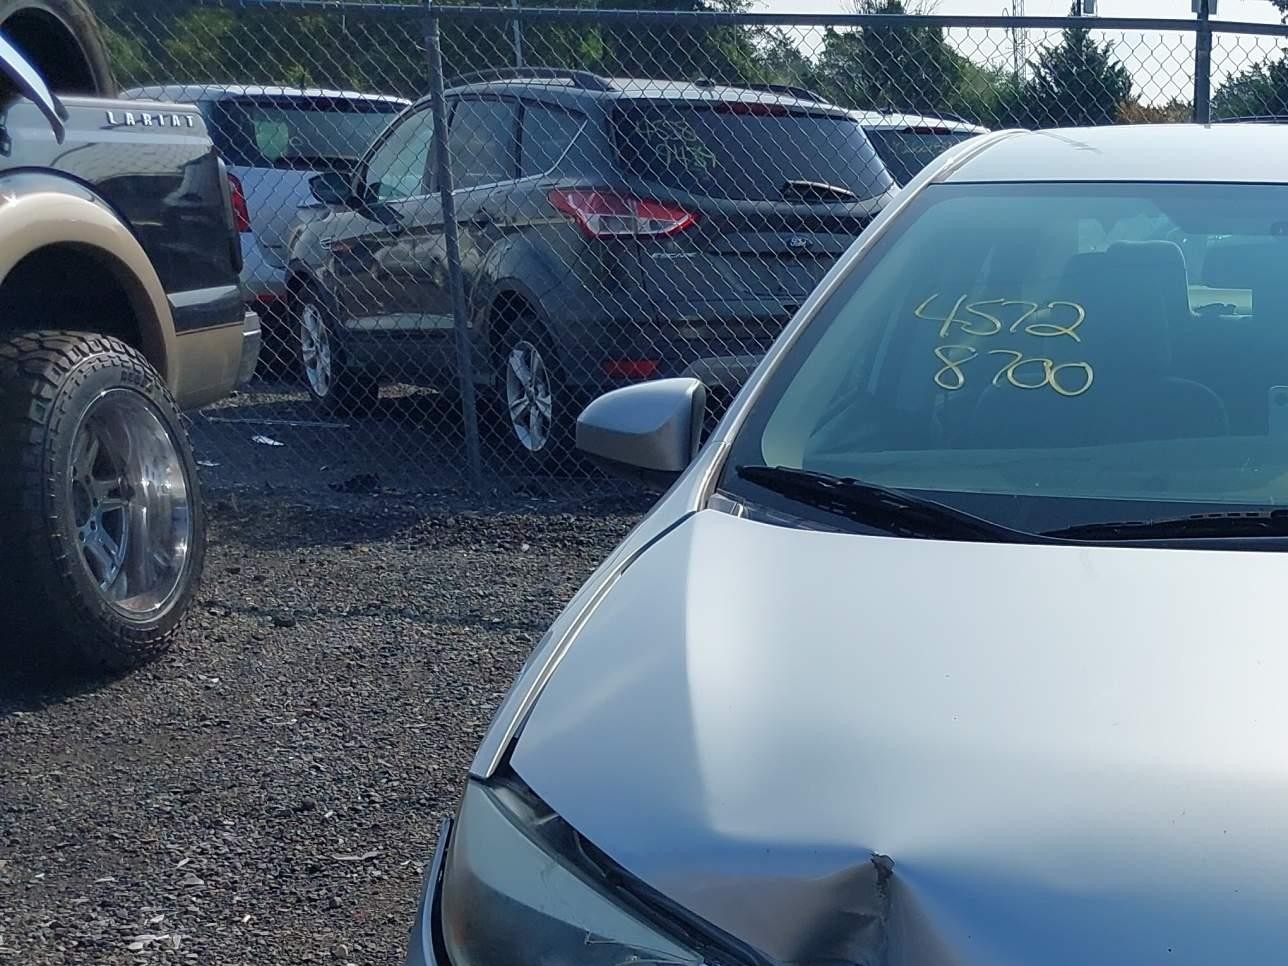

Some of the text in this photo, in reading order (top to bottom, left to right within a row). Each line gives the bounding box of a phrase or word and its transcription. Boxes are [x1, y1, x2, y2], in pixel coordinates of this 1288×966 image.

[107, 110, 194, 127] LARIAT
[914, 293, 1086, 342] 4572
[933, 345, 1095, 396] 8700
